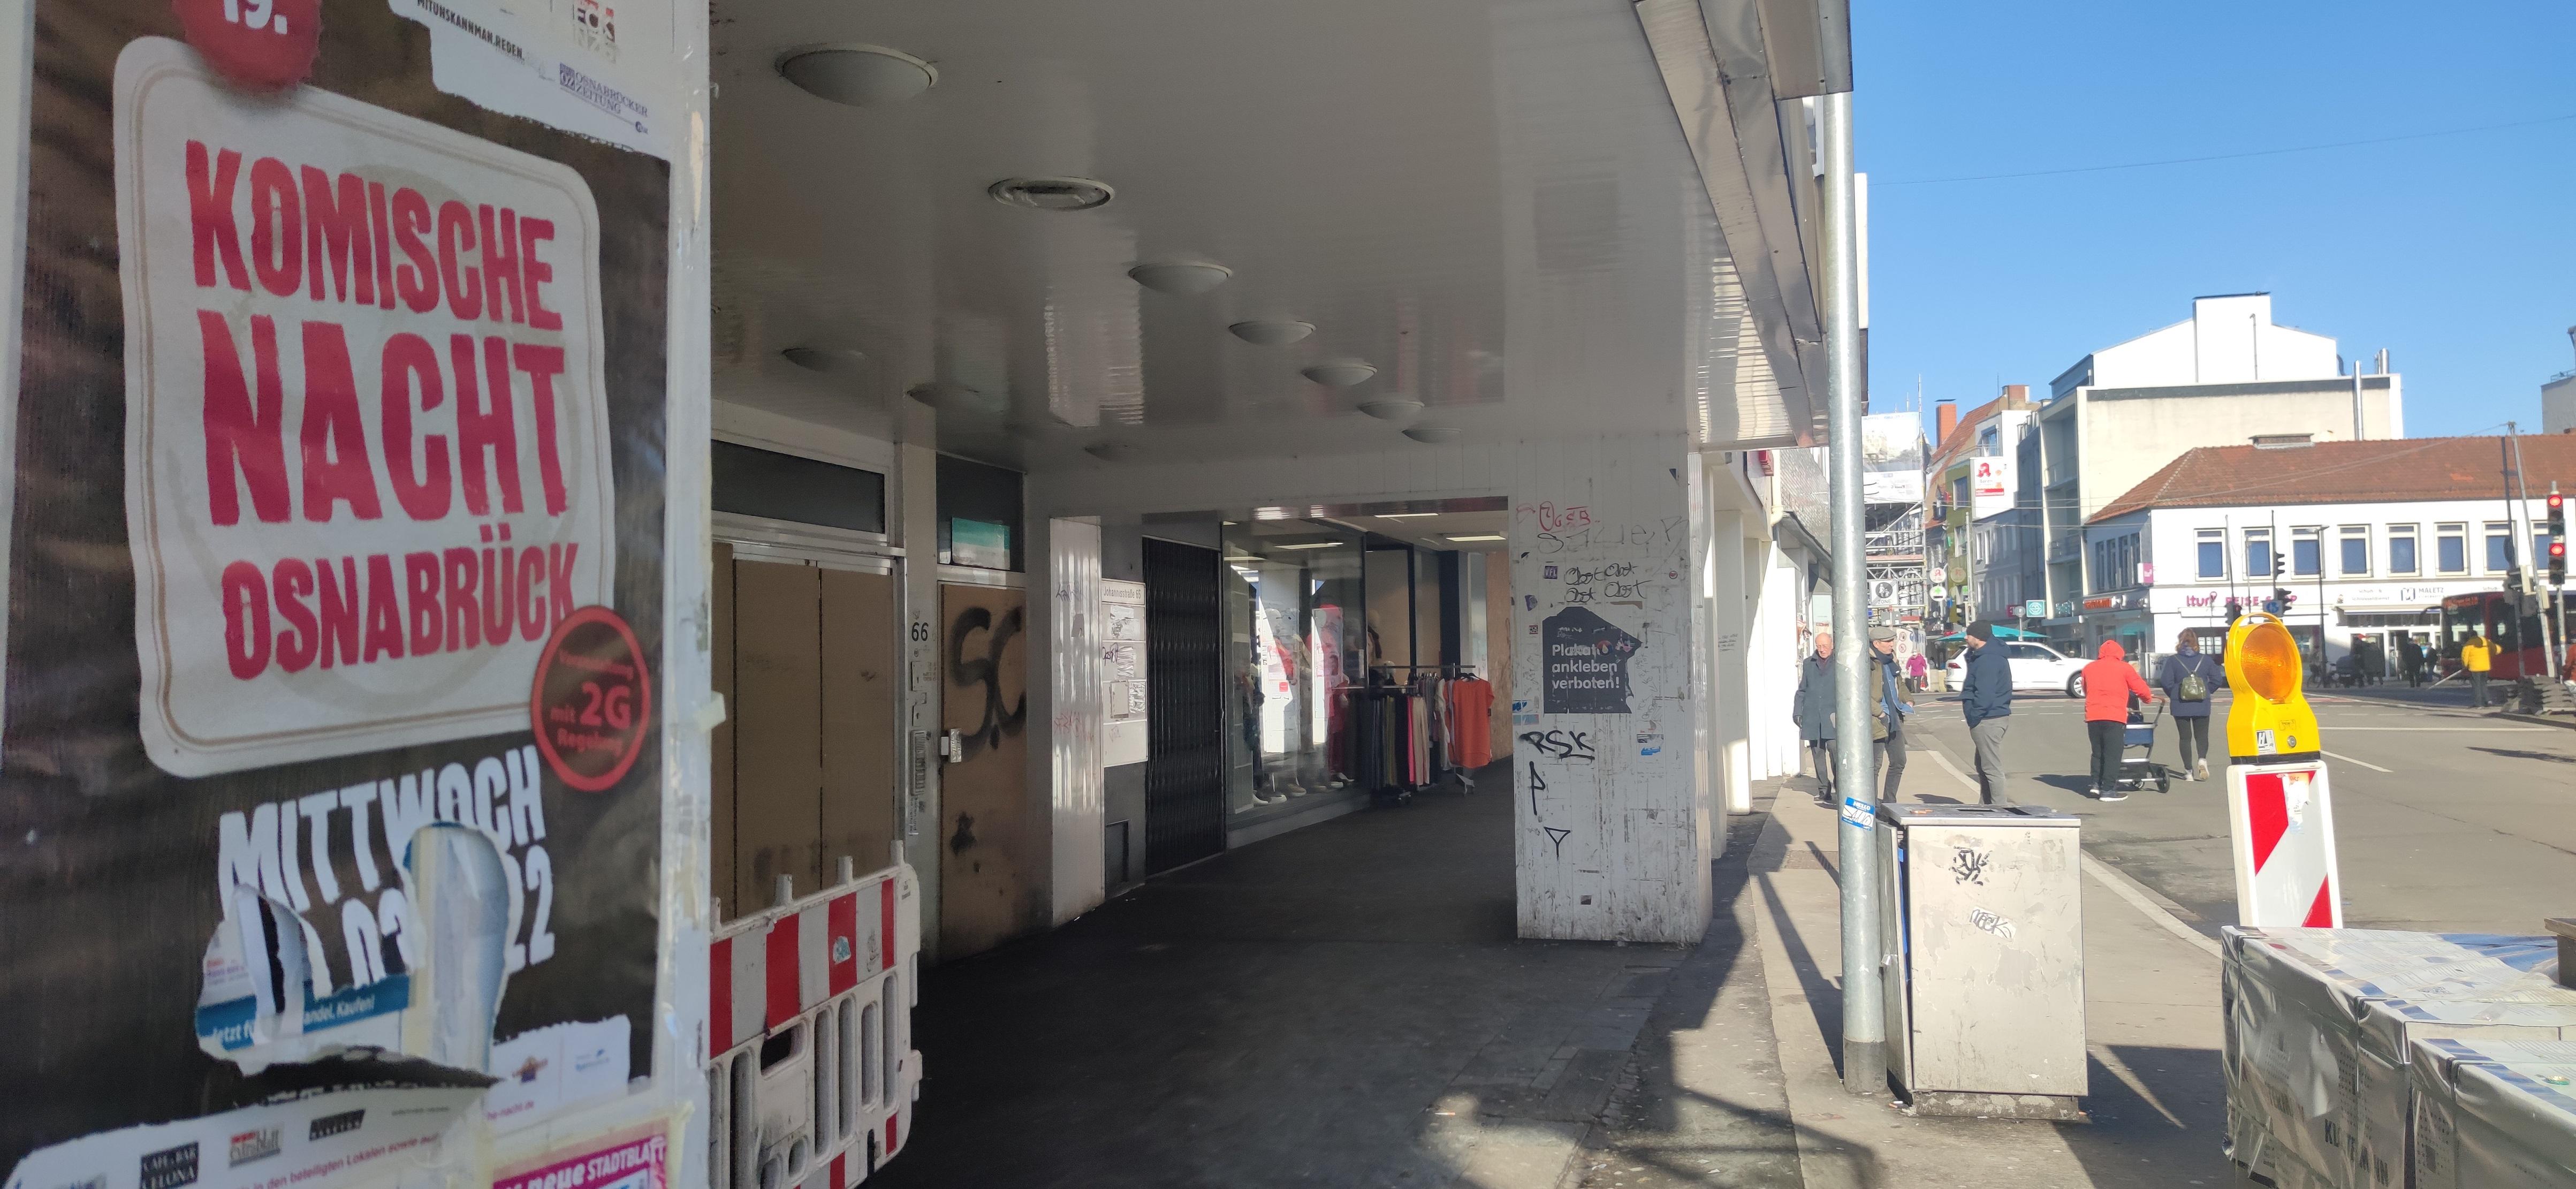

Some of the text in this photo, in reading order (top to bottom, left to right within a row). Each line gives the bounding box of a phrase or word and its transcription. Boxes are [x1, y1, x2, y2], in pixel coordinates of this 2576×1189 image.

[186, 139, 564, 331] KOMISCHE
[197, 309, 567, 527] NACHT
[221, 525, 579, 681] OSNABRÜCK
[1104, 586, 1141, 599] Johannisstraße 65
[911, 622, 929, 642] 66
[1552, 644, 1601, 657] Plakat
[1552, 659, 1617, 673] ankleben
[1552, 676, 1620, 689] verboten!
[580, 681, 632, 729] 2G
[218, 745, 546, 920] MITTWOCH
[347, 1146, 386, 1167] Lokalen
[587, 1135, 665, 1181] STADTBLATT
